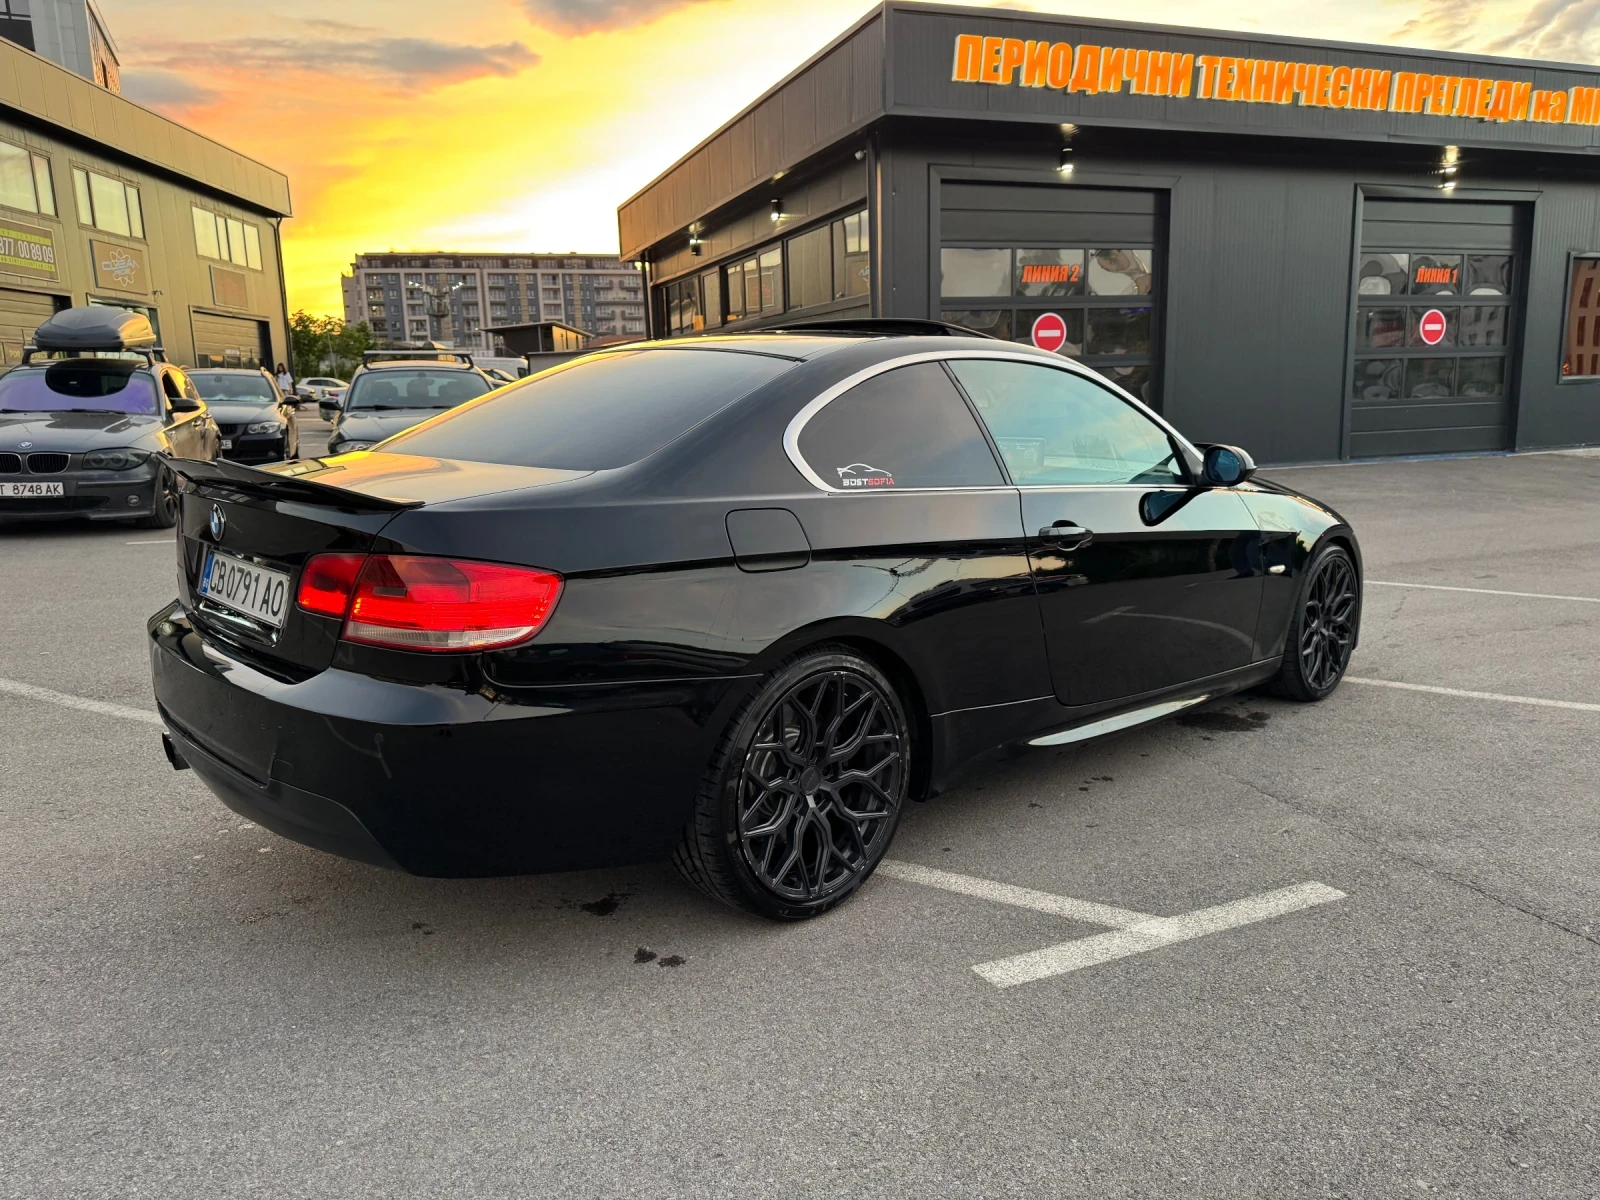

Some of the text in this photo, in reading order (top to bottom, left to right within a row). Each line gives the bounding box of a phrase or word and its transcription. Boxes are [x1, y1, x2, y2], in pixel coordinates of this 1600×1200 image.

[952, 34, 1600, 126] ПЕРИОДИЧНИ ТЕХНИЧЕСКИ ПРЕГЛЕДИ на М
[1021, 264, 1080, 283] ЛИНИЯ 2
[1415, 267, 1458, 284] ЛИНИЯ 1
[12, 484, 43, 495] 8748
[45, 484, 61, 495] AK
[226, 565, 261, 609] 0791
